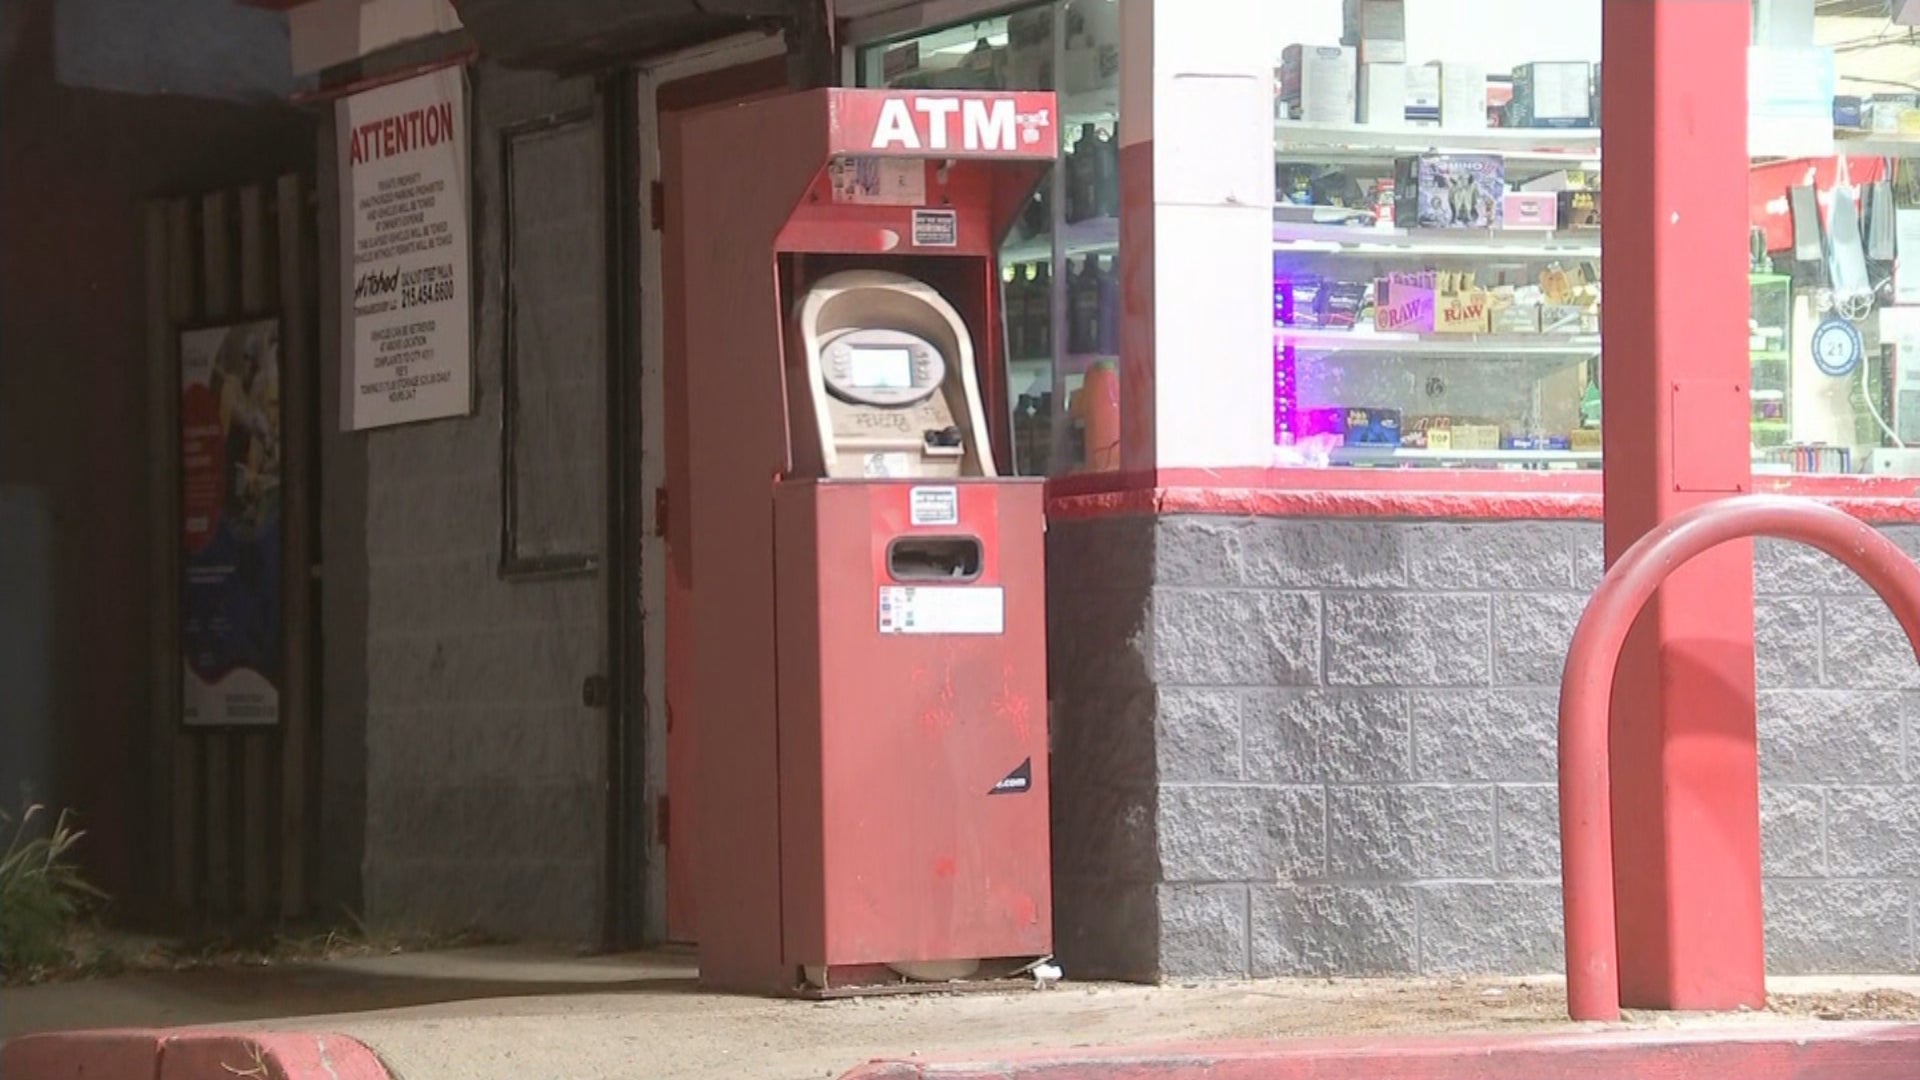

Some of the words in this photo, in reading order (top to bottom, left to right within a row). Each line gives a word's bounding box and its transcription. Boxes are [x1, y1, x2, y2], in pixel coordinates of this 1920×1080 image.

[350, 102, 453, 166] ATTENTION
[871, 97, 1017, 150] ATM
[1389, 299, 1420, 327] RAW
[1444, 305, 1483, 322] RAW
